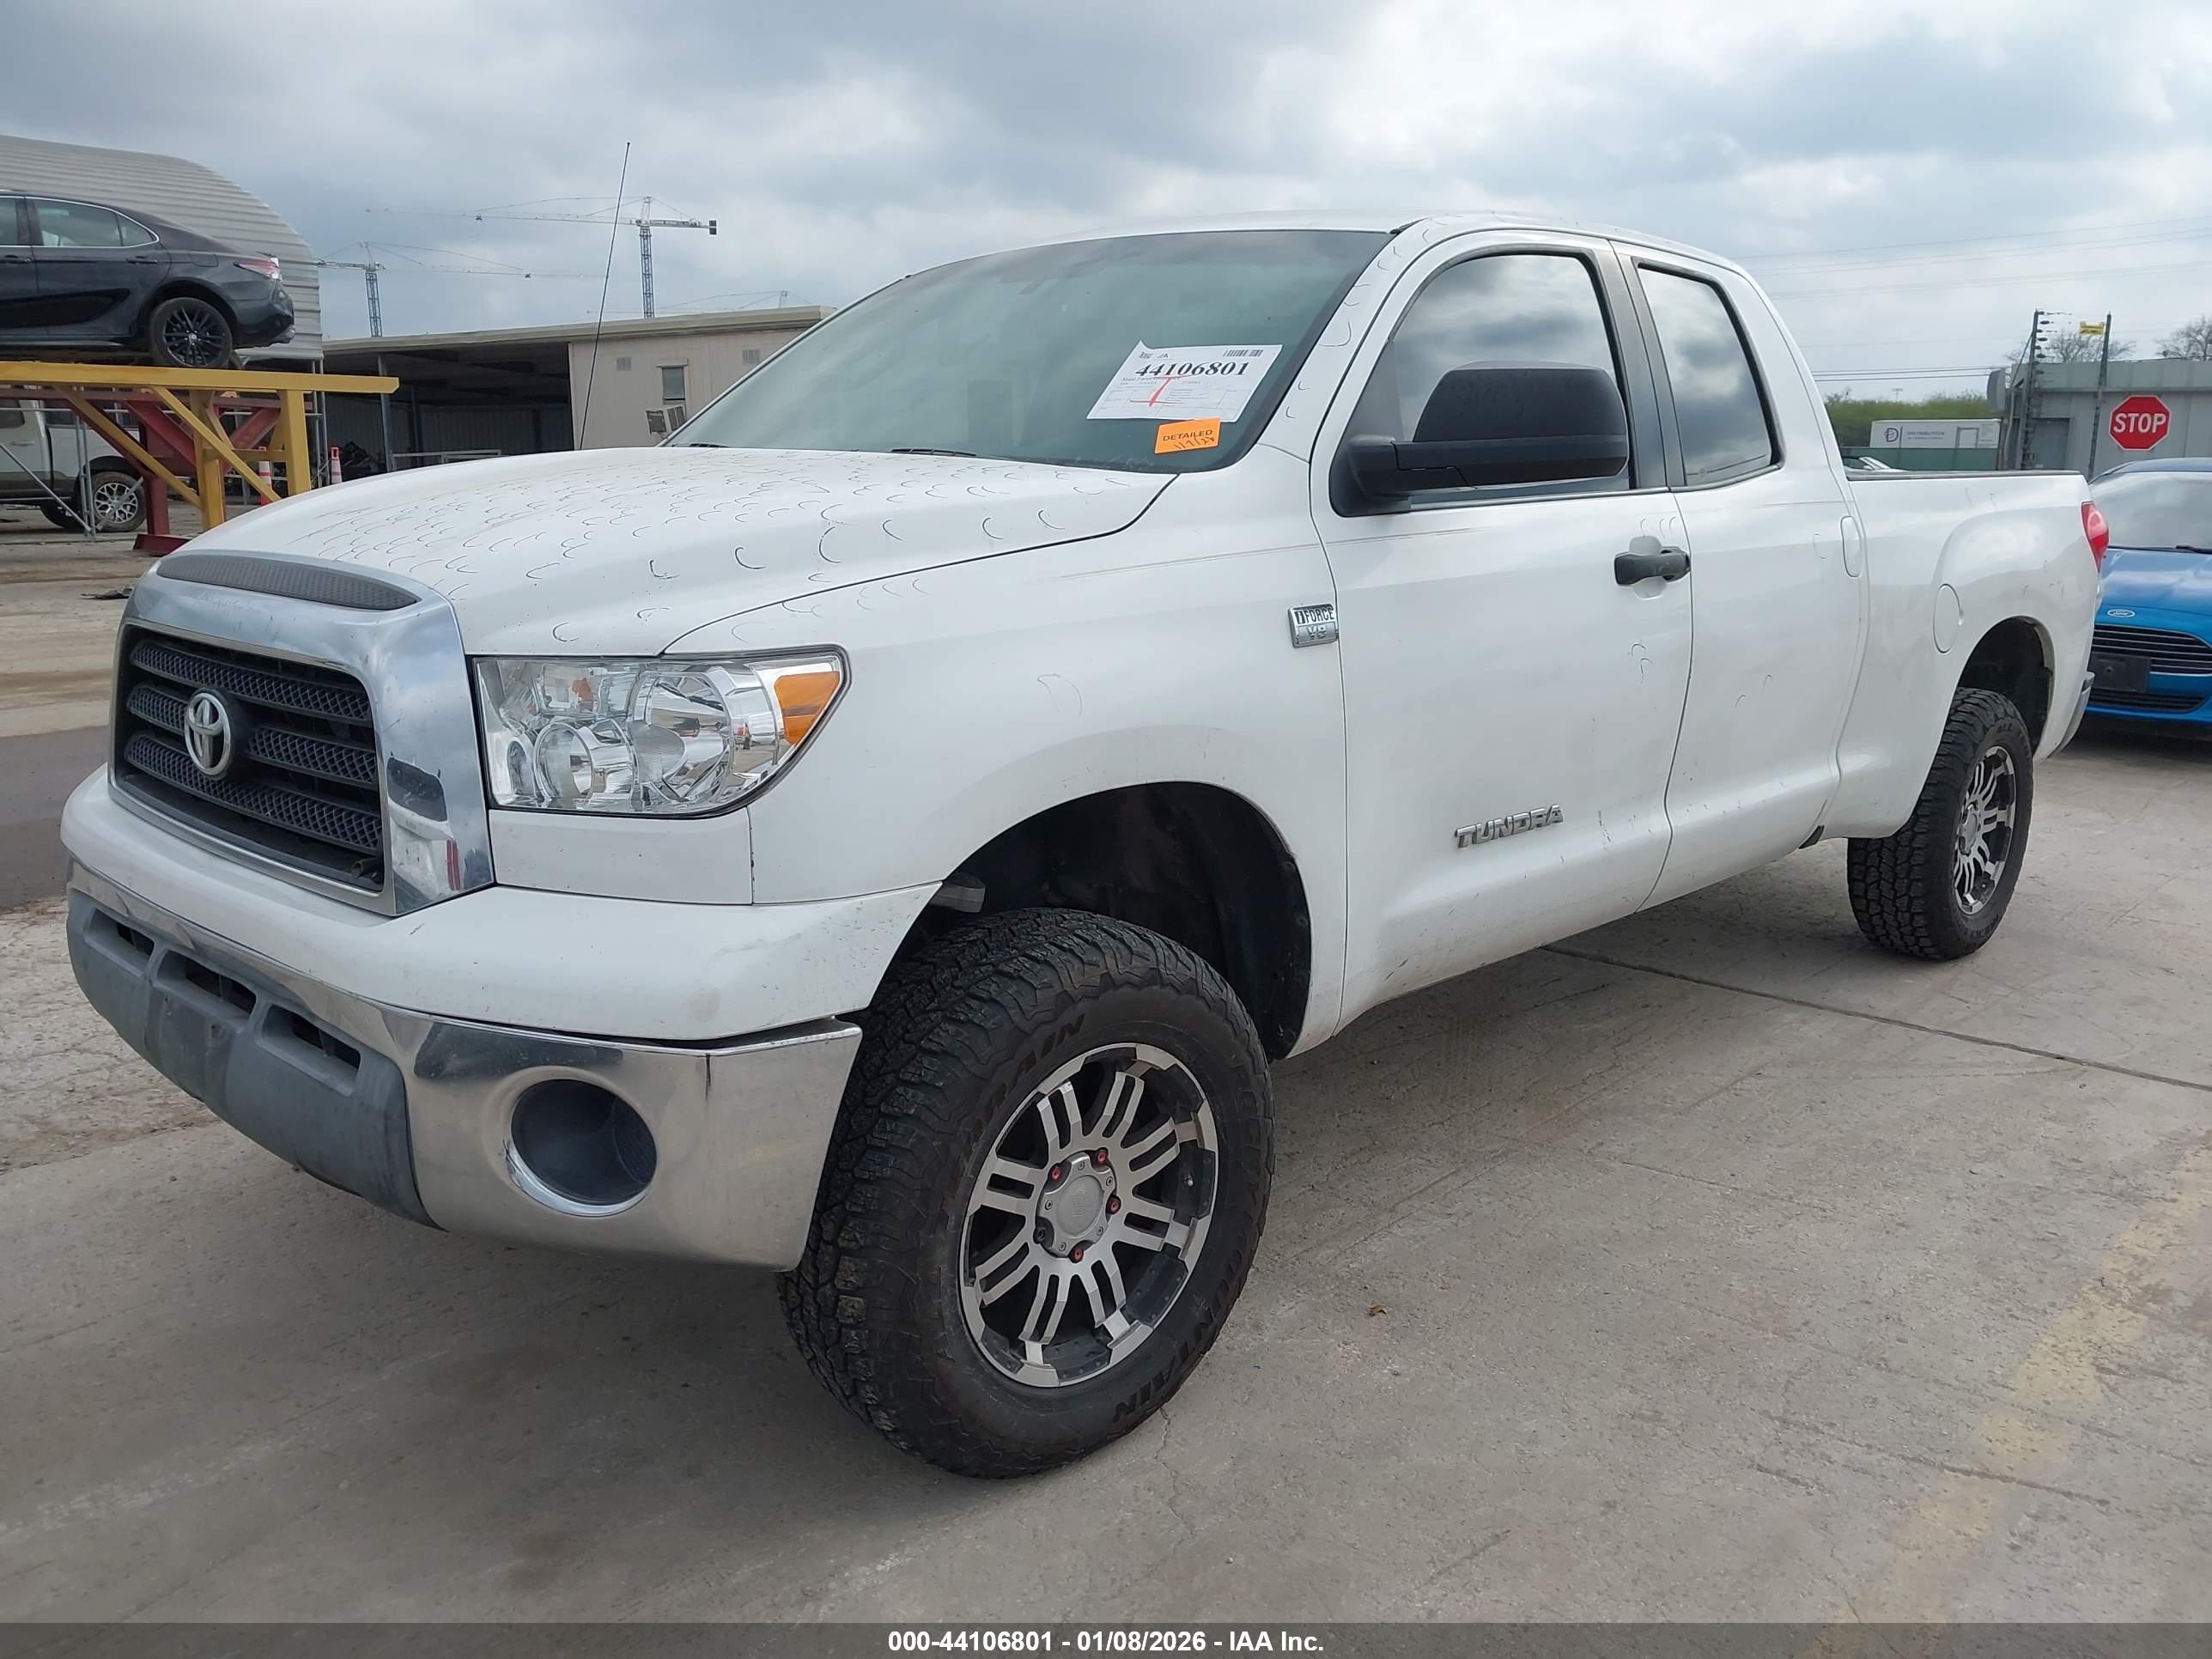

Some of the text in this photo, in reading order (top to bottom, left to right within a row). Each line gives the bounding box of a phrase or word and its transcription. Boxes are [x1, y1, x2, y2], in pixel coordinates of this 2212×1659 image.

[1134, 362, 1249, 377] 44106801
[2113, 412, 2166, 434] STOP
[1163, 429, 1213, 441] DETAILED
[1454, 804, 1564, 848] TUNDRA
